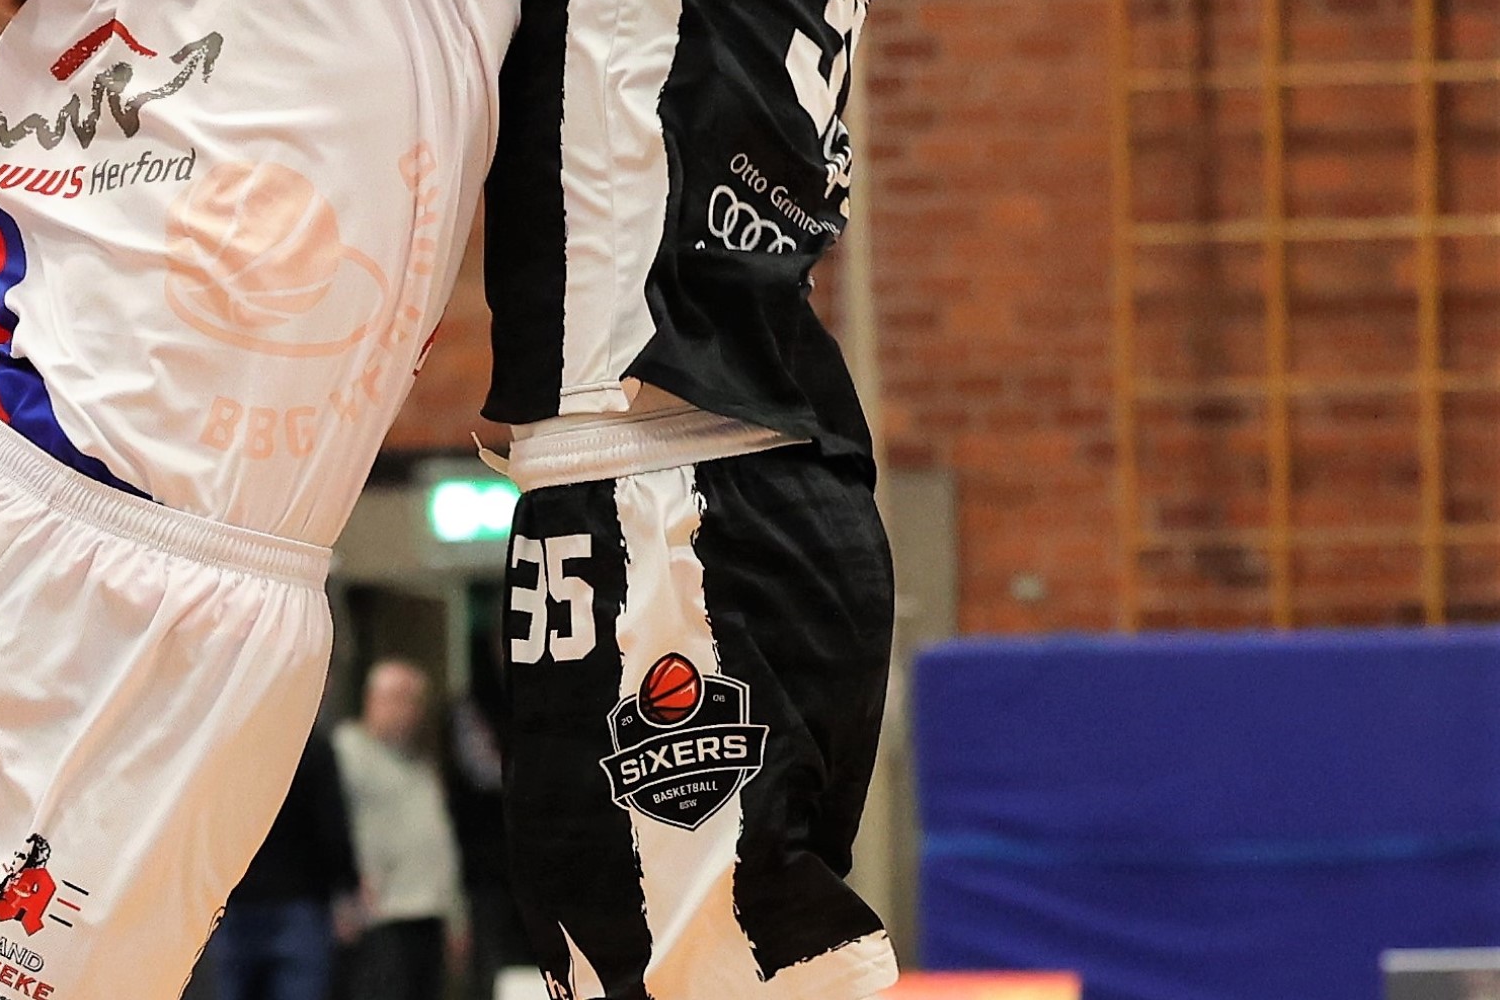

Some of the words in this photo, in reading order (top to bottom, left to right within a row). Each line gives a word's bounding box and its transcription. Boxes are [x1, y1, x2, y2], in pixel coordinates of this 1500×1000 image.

[88, 146, 197, 196] Herford
[730, 153, 767, 193] Otto
[200, 396, 317, 461] BBG
[510, 533, 597, 664] 35
[652, 780, 719, 804] BASKETBALL
